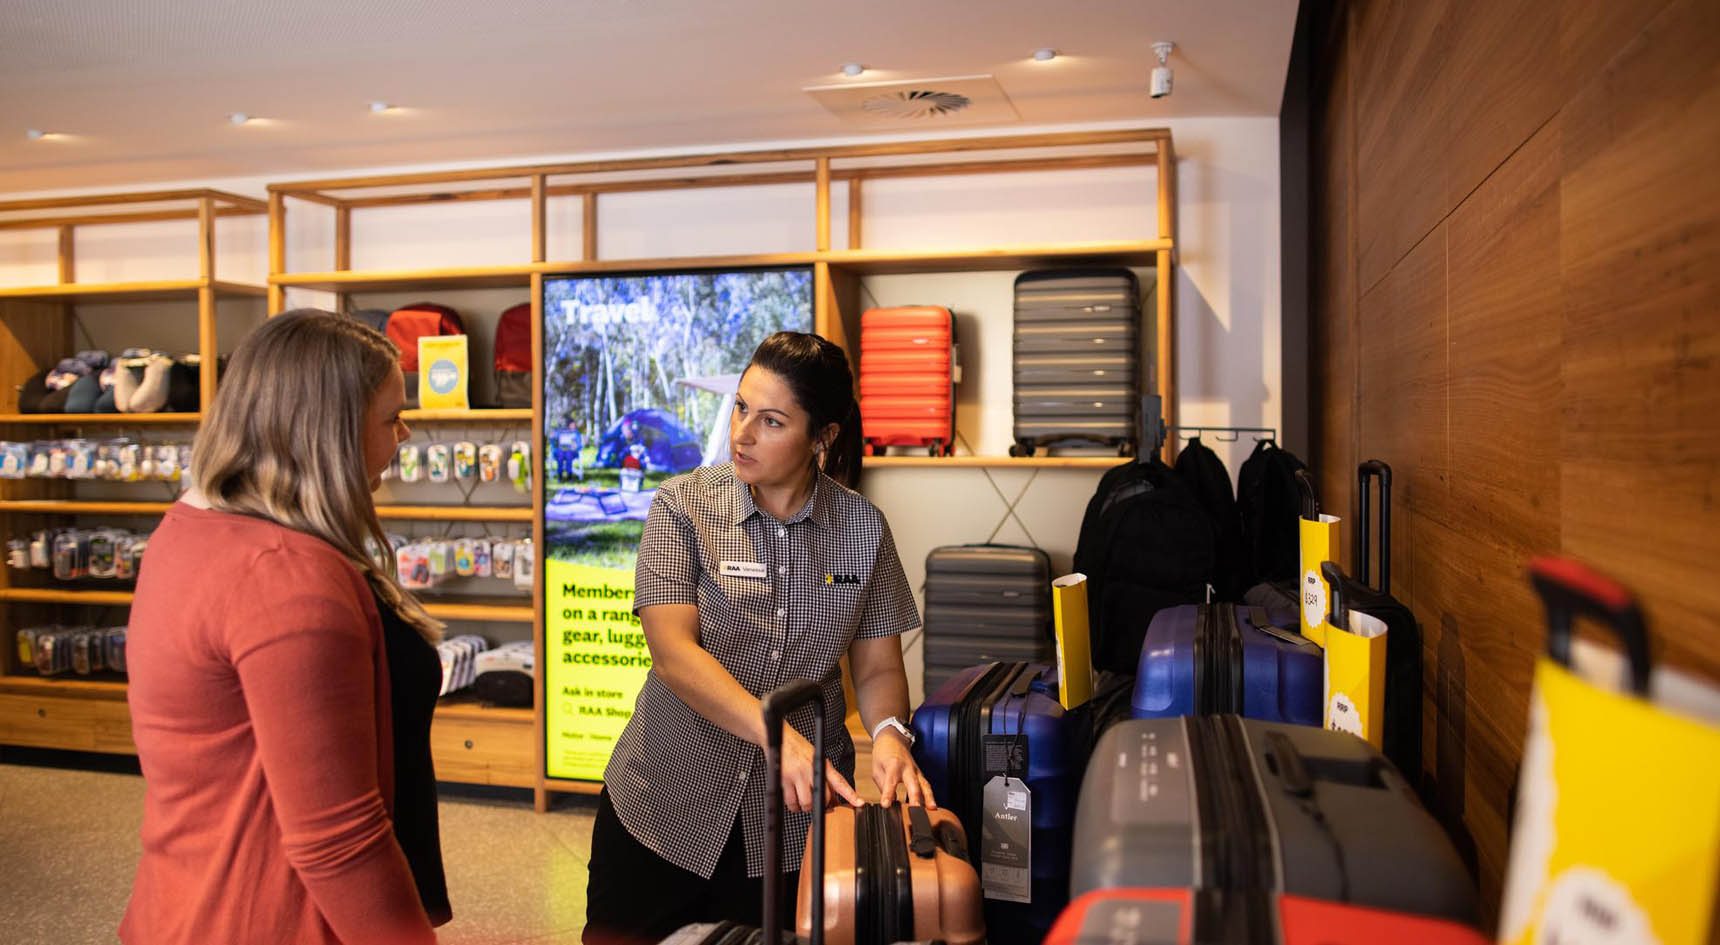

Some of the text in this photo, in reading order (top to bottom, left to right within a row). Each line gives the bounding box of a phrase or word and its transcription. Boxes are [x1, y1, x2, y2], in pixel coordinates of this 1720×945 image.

[561, 295, 650, 325] Travel
[834, 574, 860, 585] RAA
[562, 583, 635, 599] Member
[562, 608, 583, 620] on
[588, 609, 598, 621] a
[562, 630, 604, 646] gear,
[562, 651, 653, 668] accessorie
[562, 686, 623, 700] Ask in store
[579, 705, 632, 720] RAA Shop
[994, 812, 1018, 822] Antler
